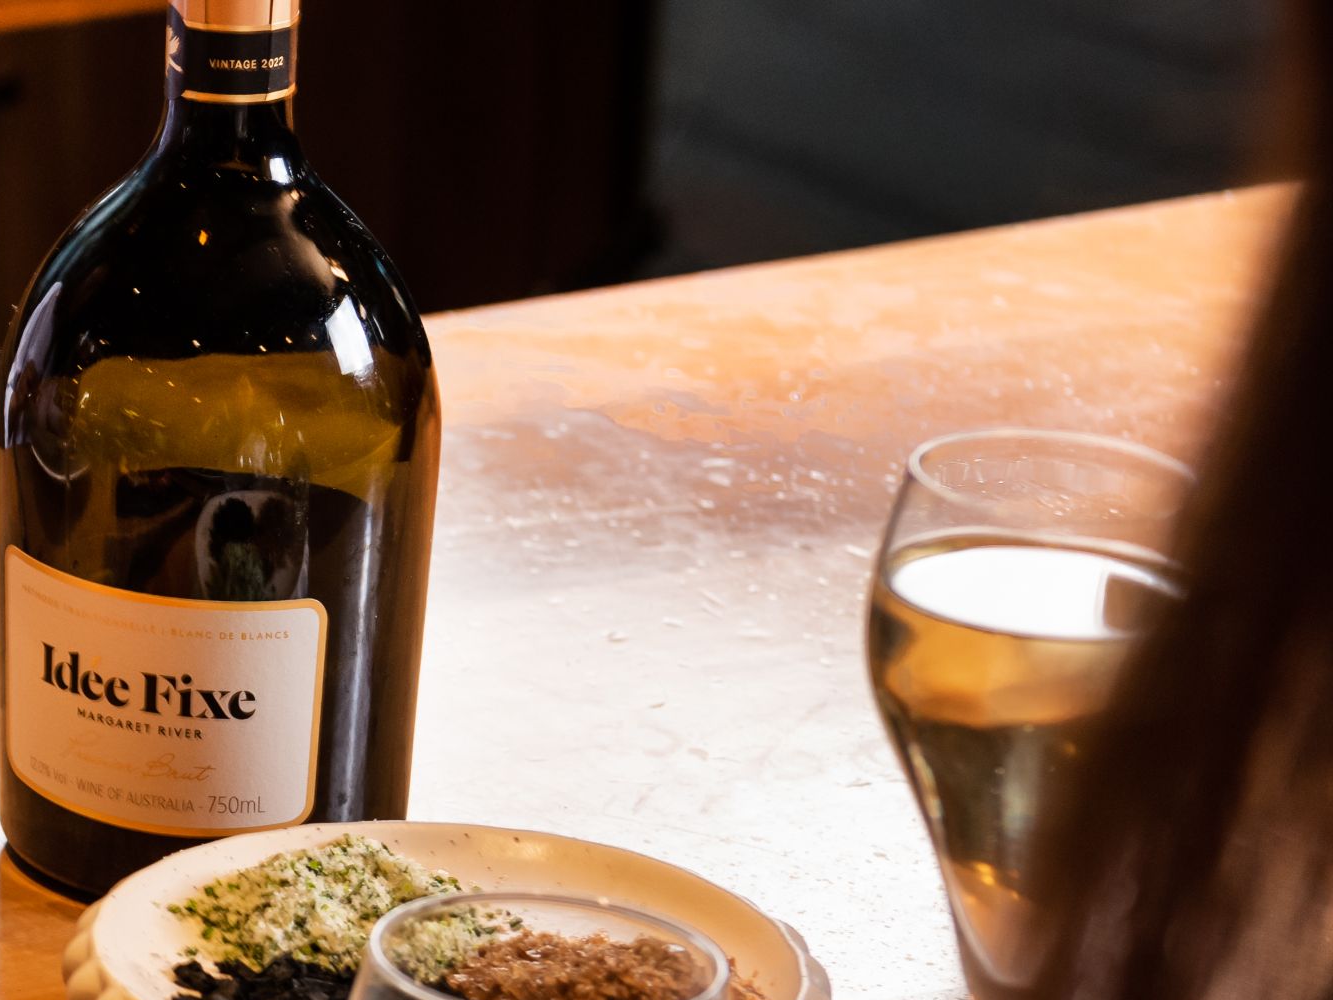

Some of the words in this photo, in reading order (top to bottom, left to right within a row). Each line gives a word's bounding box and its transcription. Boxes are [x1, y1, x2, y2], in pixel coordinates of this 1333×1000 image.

[209, 58, 257, 70] VINTAGE
[261, 56, 284, 69] 2022
[170, 628, 212, 640] BLANC
[219, 630, 235, 641] DE
[241, 630, 290, 641] BLANCS
[141, 671, 256, 720] Fixe
[77, 707, 151, 734] MARGARET
[158, 725, 204, 740] RIVER
[141, 752, 216, 782] Brut
[76, 778, 104, 798] WINE
[107, 788, 123, 801] OF
[126, 791, 194, 813] AUSTRALIA
[208, 795, 266, 814] 750mL
